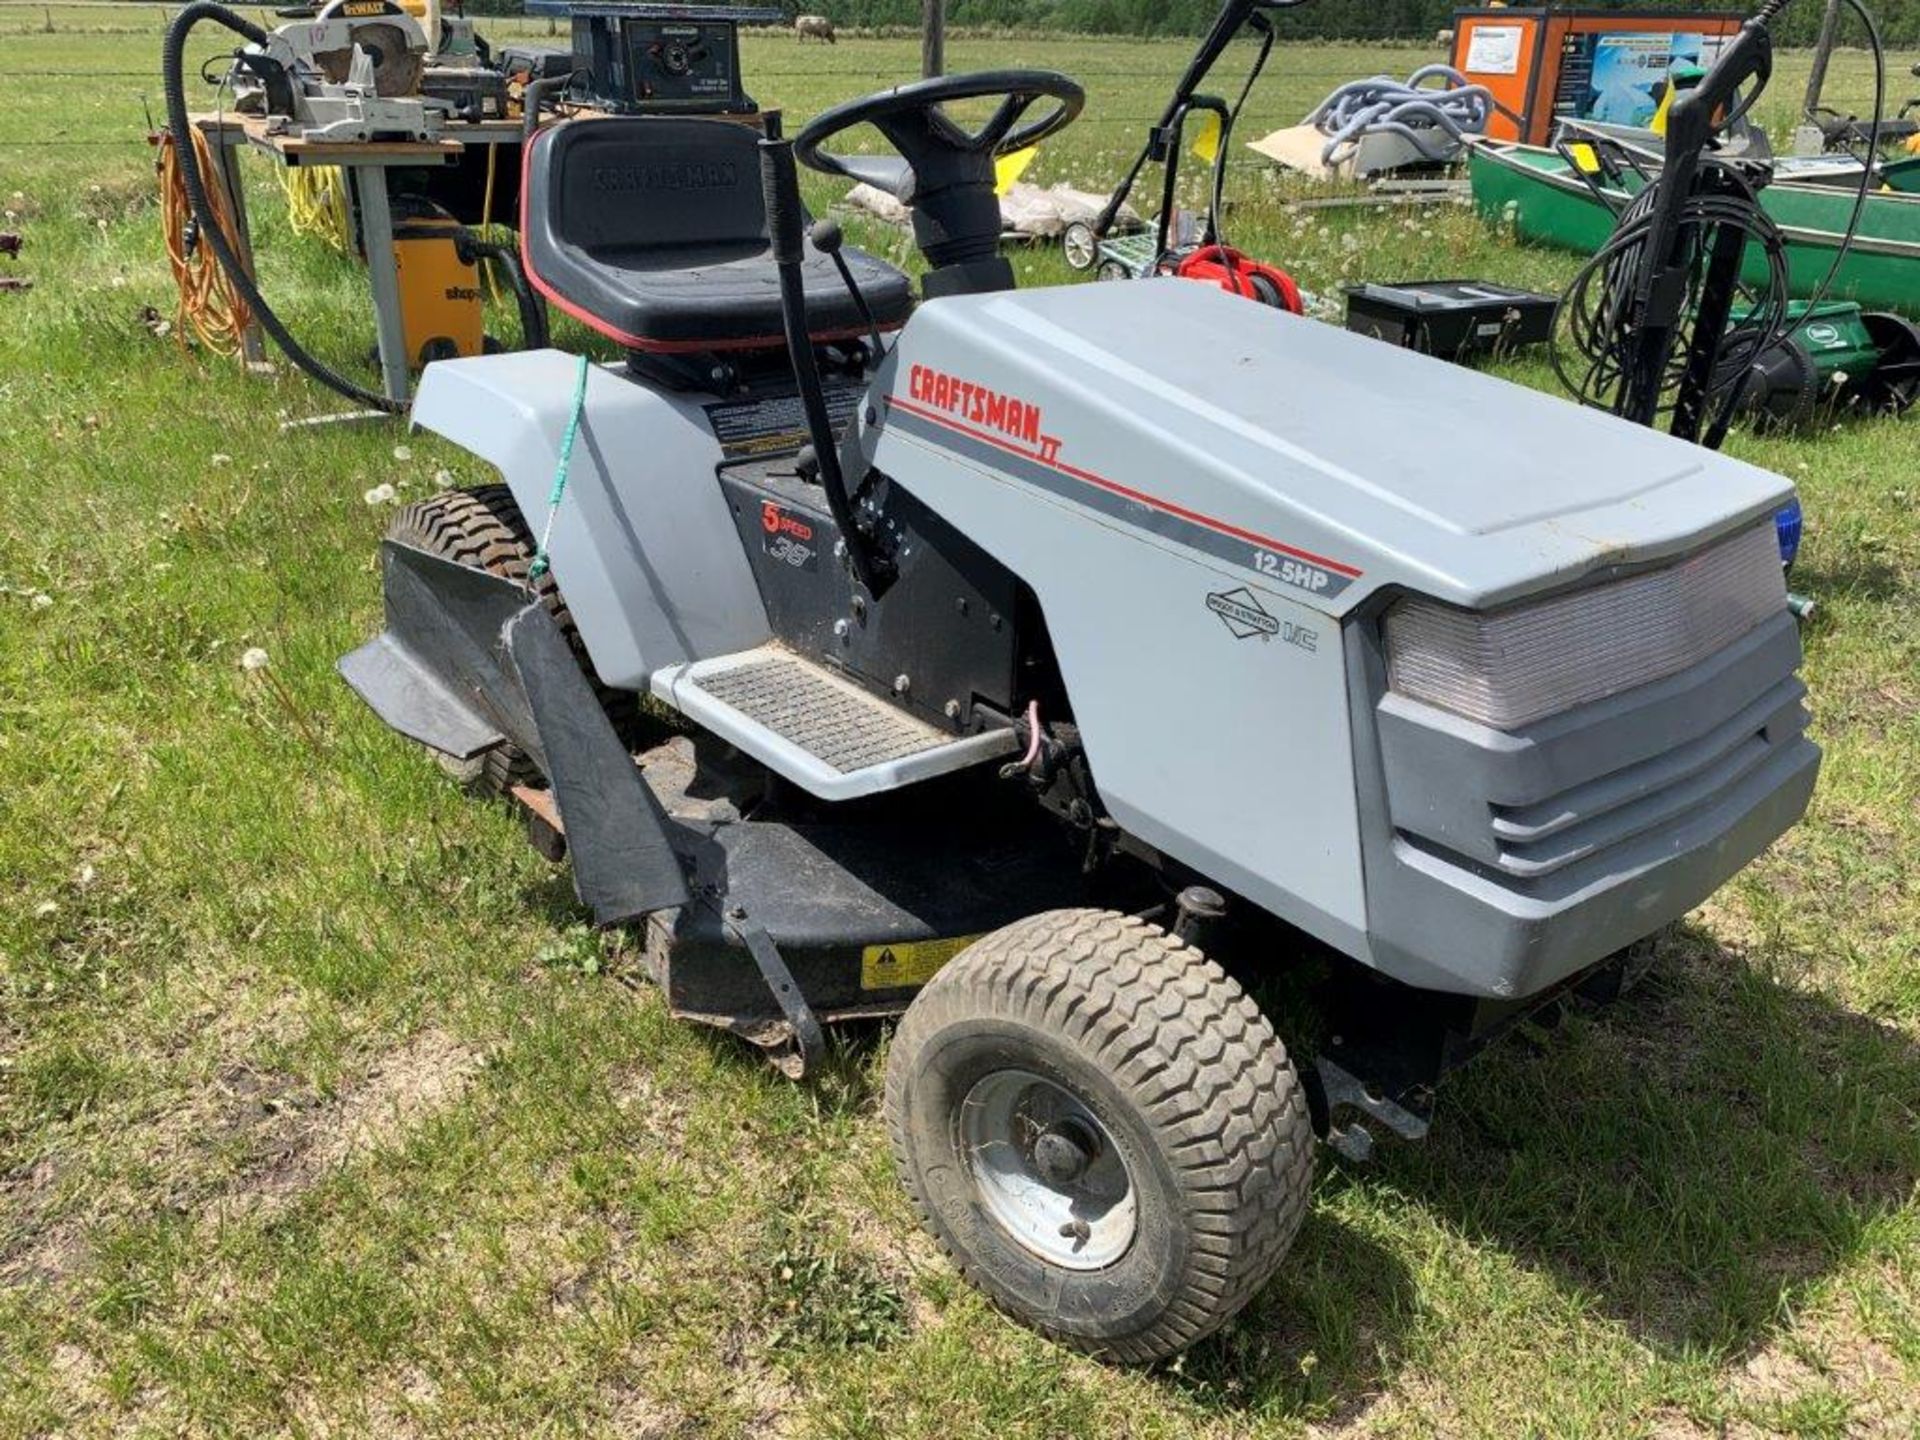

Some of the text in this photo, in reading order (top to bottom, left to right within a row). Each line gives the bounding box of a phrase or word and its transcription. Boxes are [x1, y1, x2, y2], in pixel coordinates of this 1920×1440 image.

[910, 364, 1040, 443] CRAFTSMAN
[1039, 434, 1062, 467] II
[762, 500, 813, 541] 5 SPEED
[1253, 550, 1329, 591] 12.5HP
